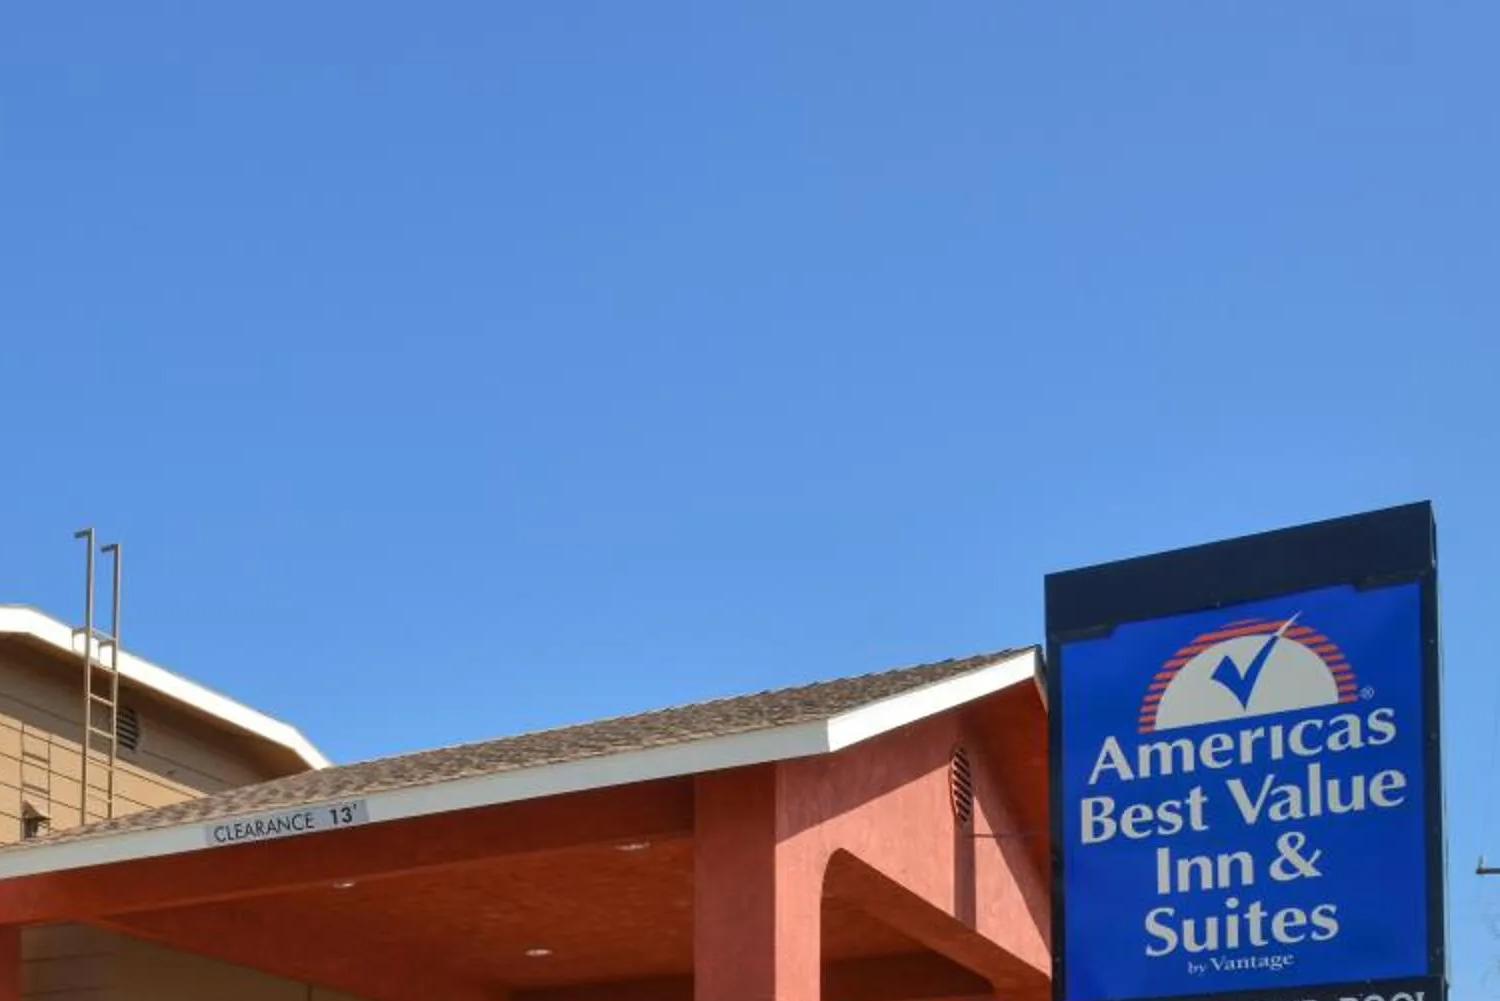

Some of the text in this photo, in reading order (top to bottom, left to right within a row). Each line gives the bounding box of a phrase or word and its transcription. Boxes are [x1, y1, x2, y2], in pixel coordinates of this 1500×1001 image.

[1088, 706, 1397, 785] Americas
[214, 812, 315, 843] CLEARANCE
[1080, 763, 1407, 844] Best Value
[1156, 831, 1323, 895] Inn &
[1144, 897, 1340, 957] Suites
[1187, 953, 1296, 976] by Vantage
